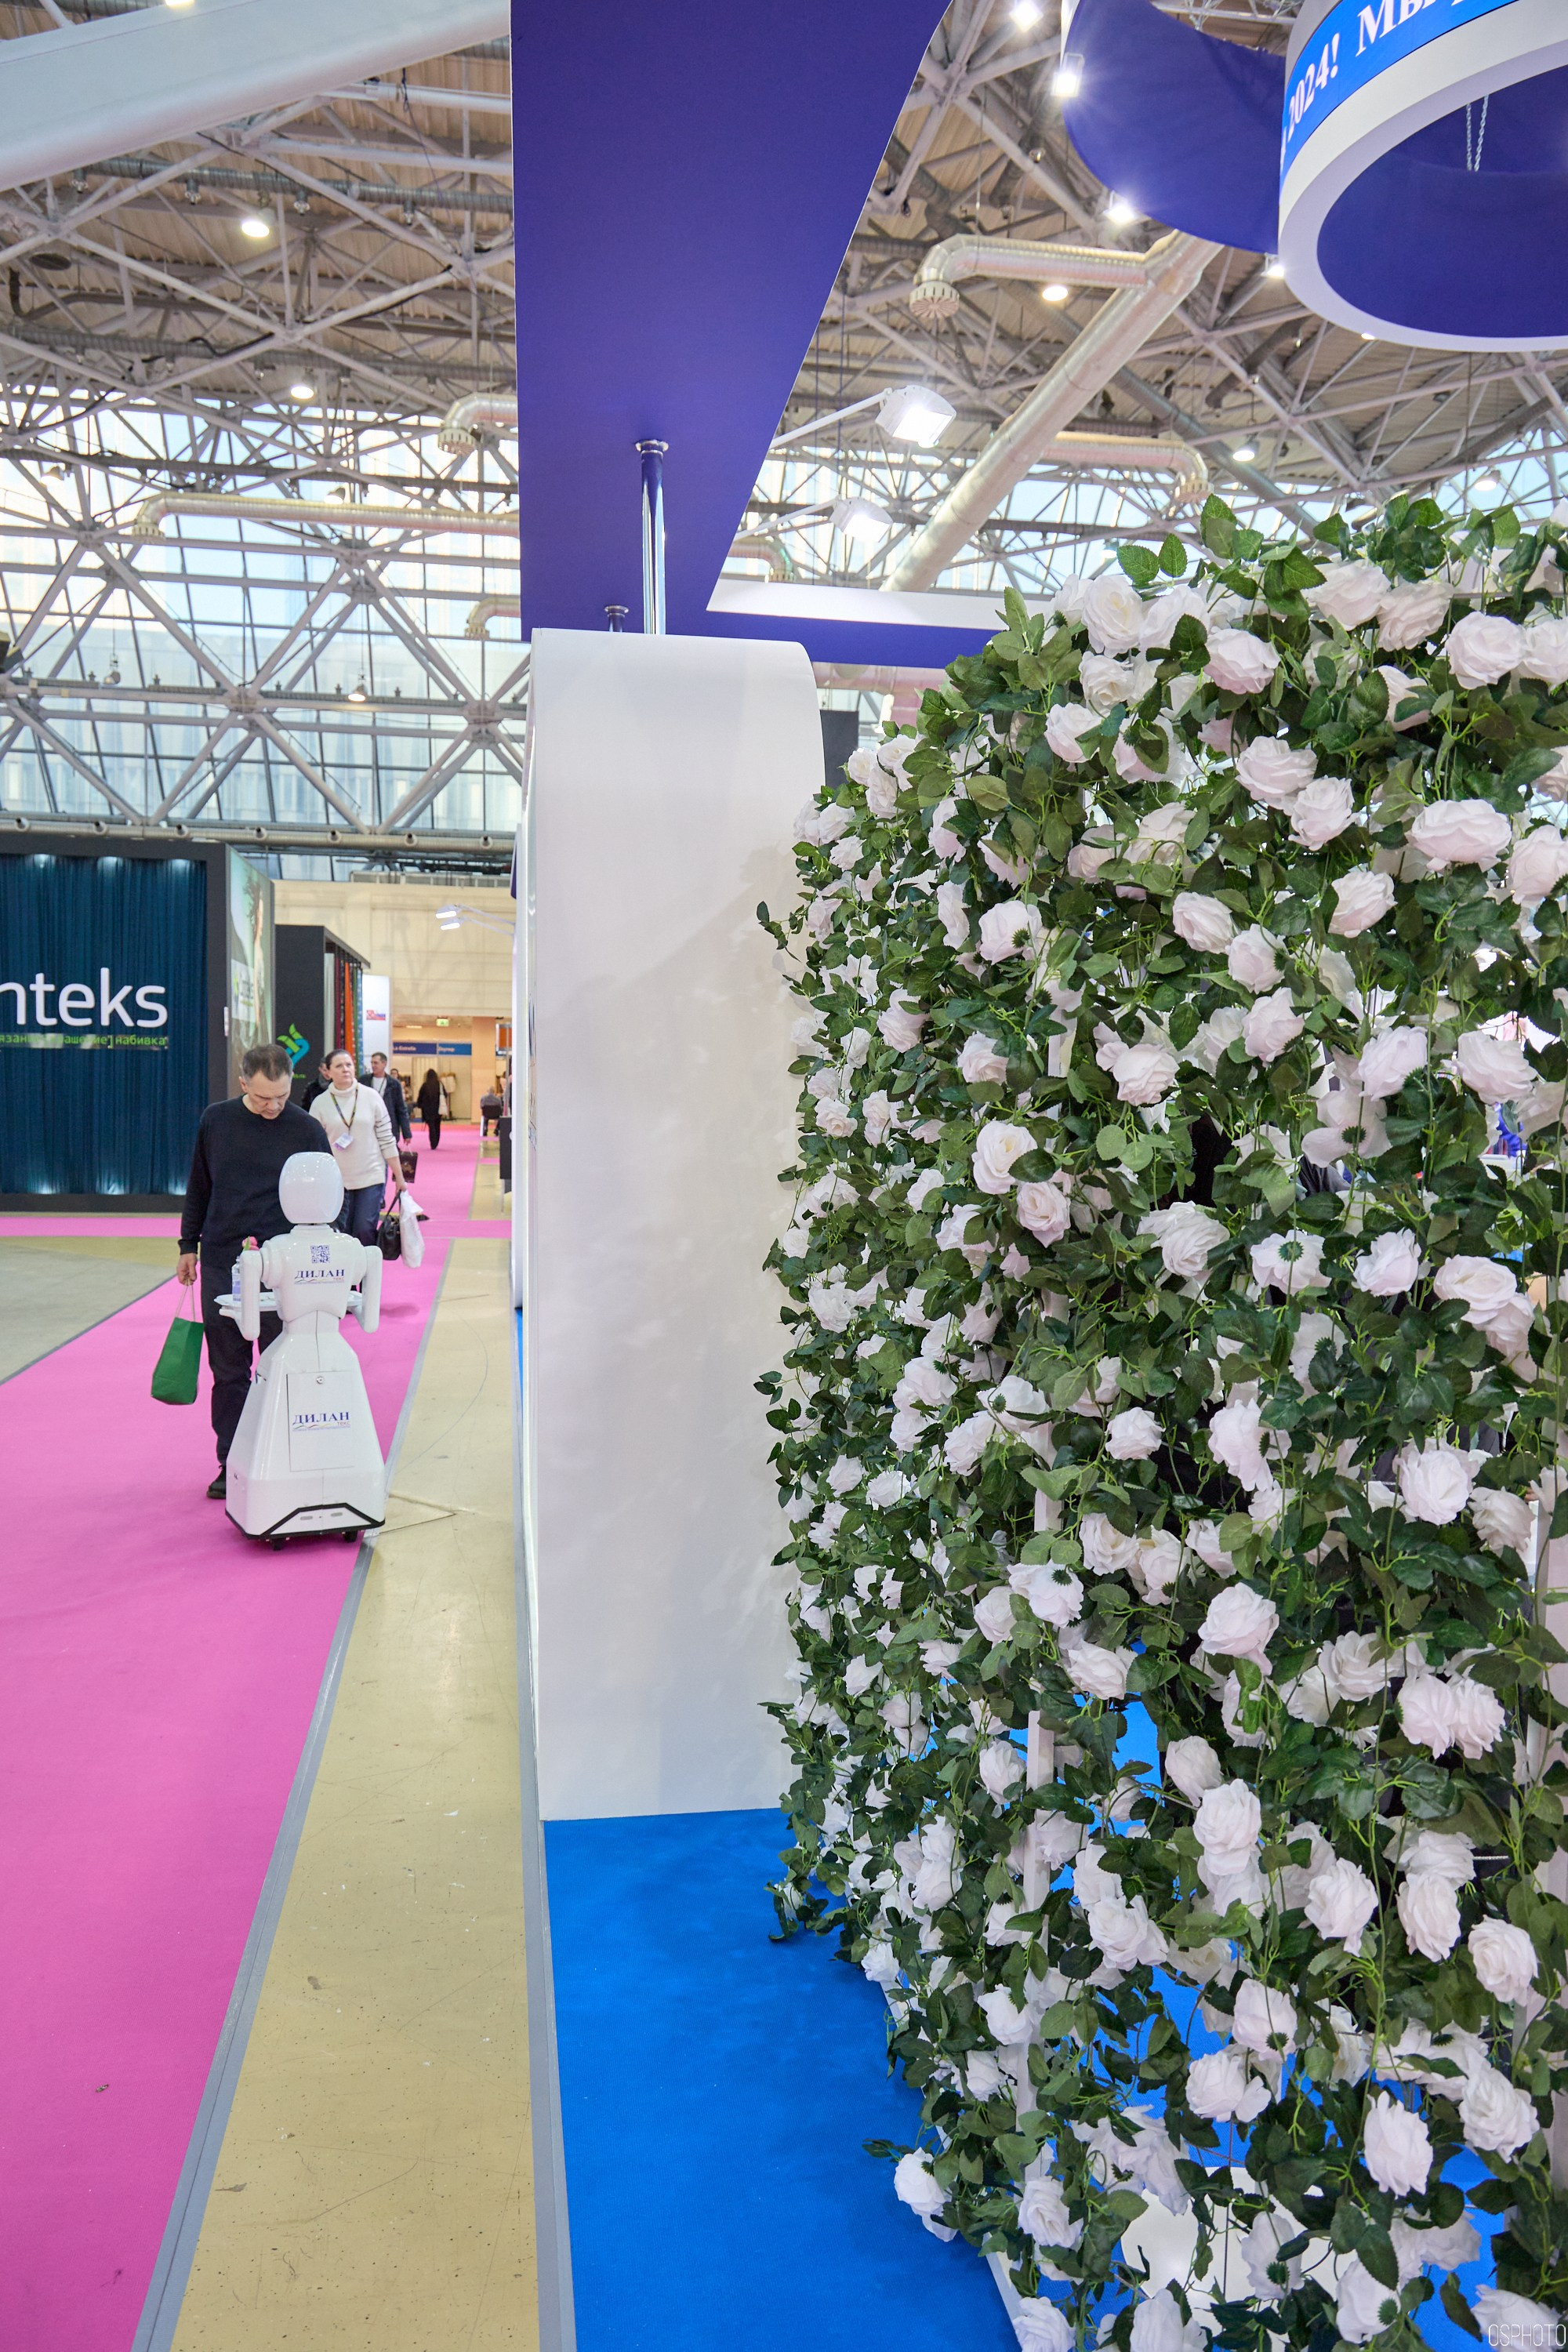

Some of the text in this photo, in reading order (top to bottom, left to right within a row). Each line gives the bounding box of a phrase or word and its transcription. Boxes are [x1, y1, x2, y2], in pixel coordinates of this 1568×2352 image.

[1287, 32, 1340, 143] 2024!
[115, 1034, 166, 1046] набивка
[294, 1269, 345, 1279] ДИЛАН
[292, 1411, 350, 1425] ДИЛАН
